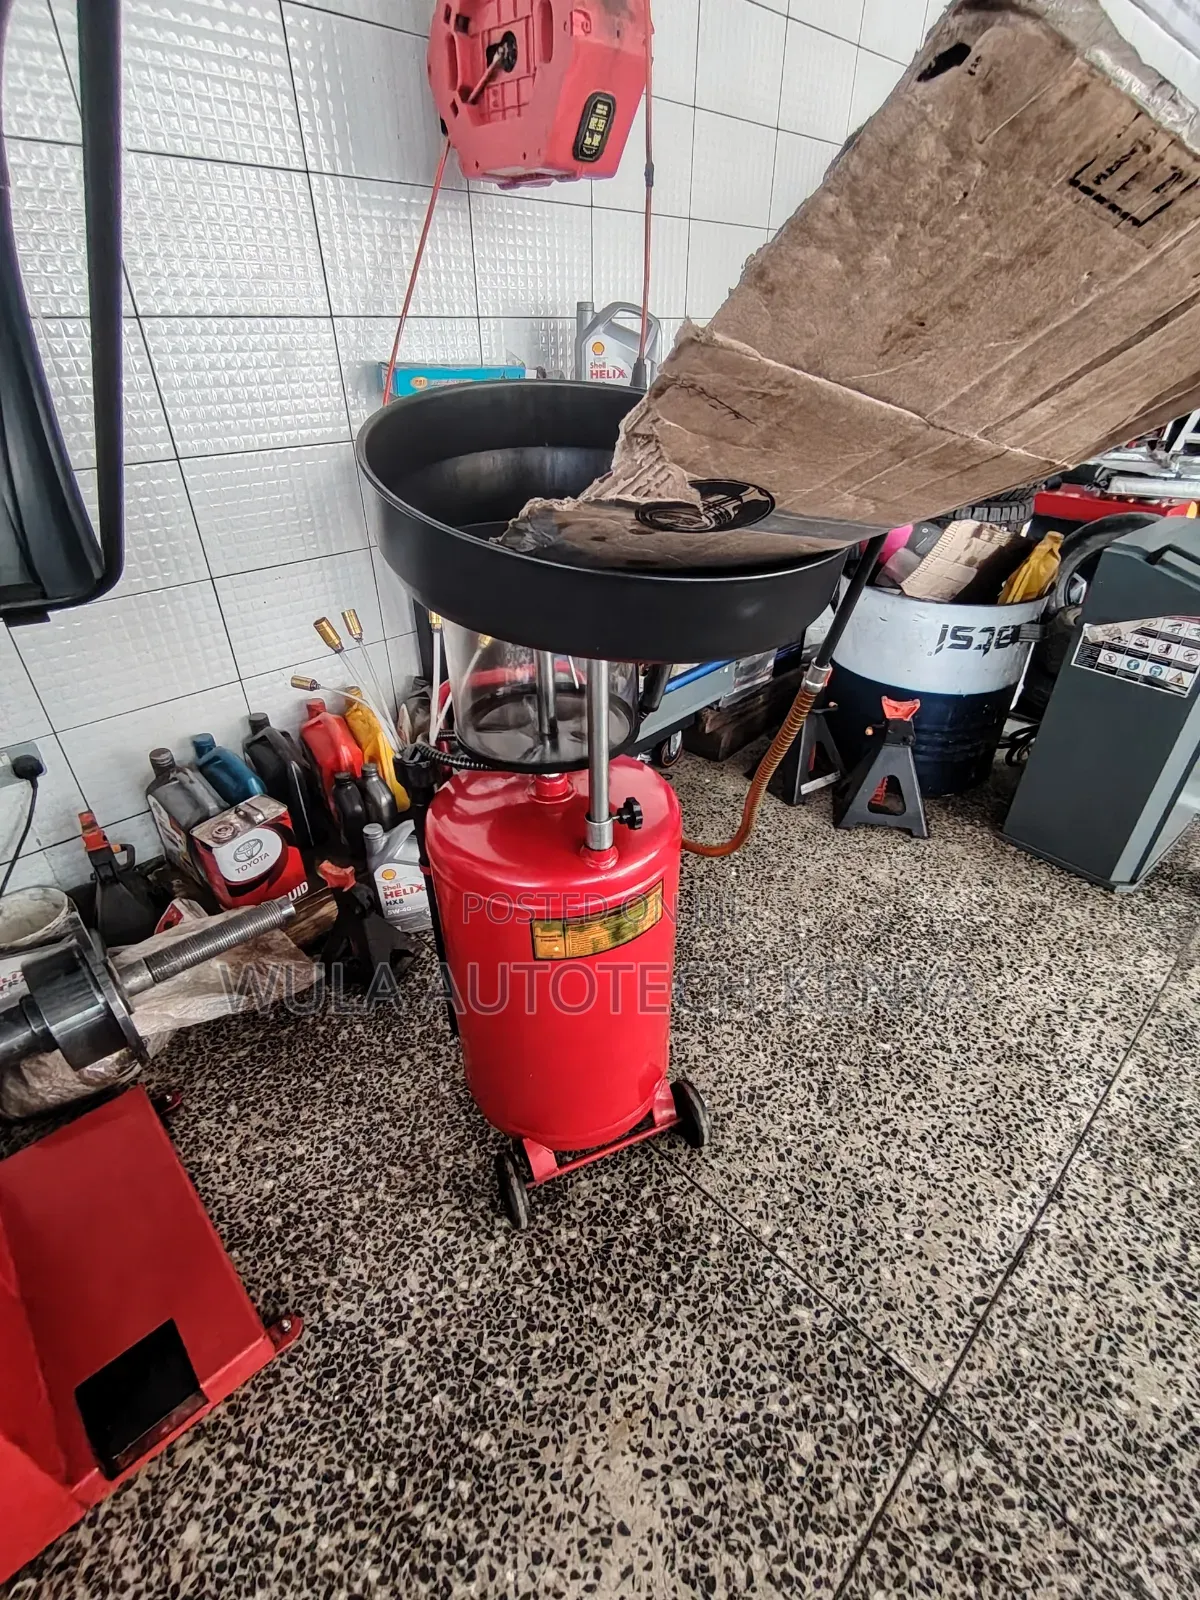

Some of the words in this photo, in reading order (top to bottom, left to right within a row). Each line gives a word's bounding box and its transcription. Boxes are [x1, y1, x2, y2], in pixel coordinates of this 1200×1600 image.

[590, 360, 606, 369] Shell
[590, 365, 628, 378] HELIX
[235, 852, 270, 874] TOYOTA
[288, 881, 309, 902] UID
[382, 883, 401, 892] Shell
[383, 884, 426, 899] HELIX
[387, 906, 411, 916] 5W-40
